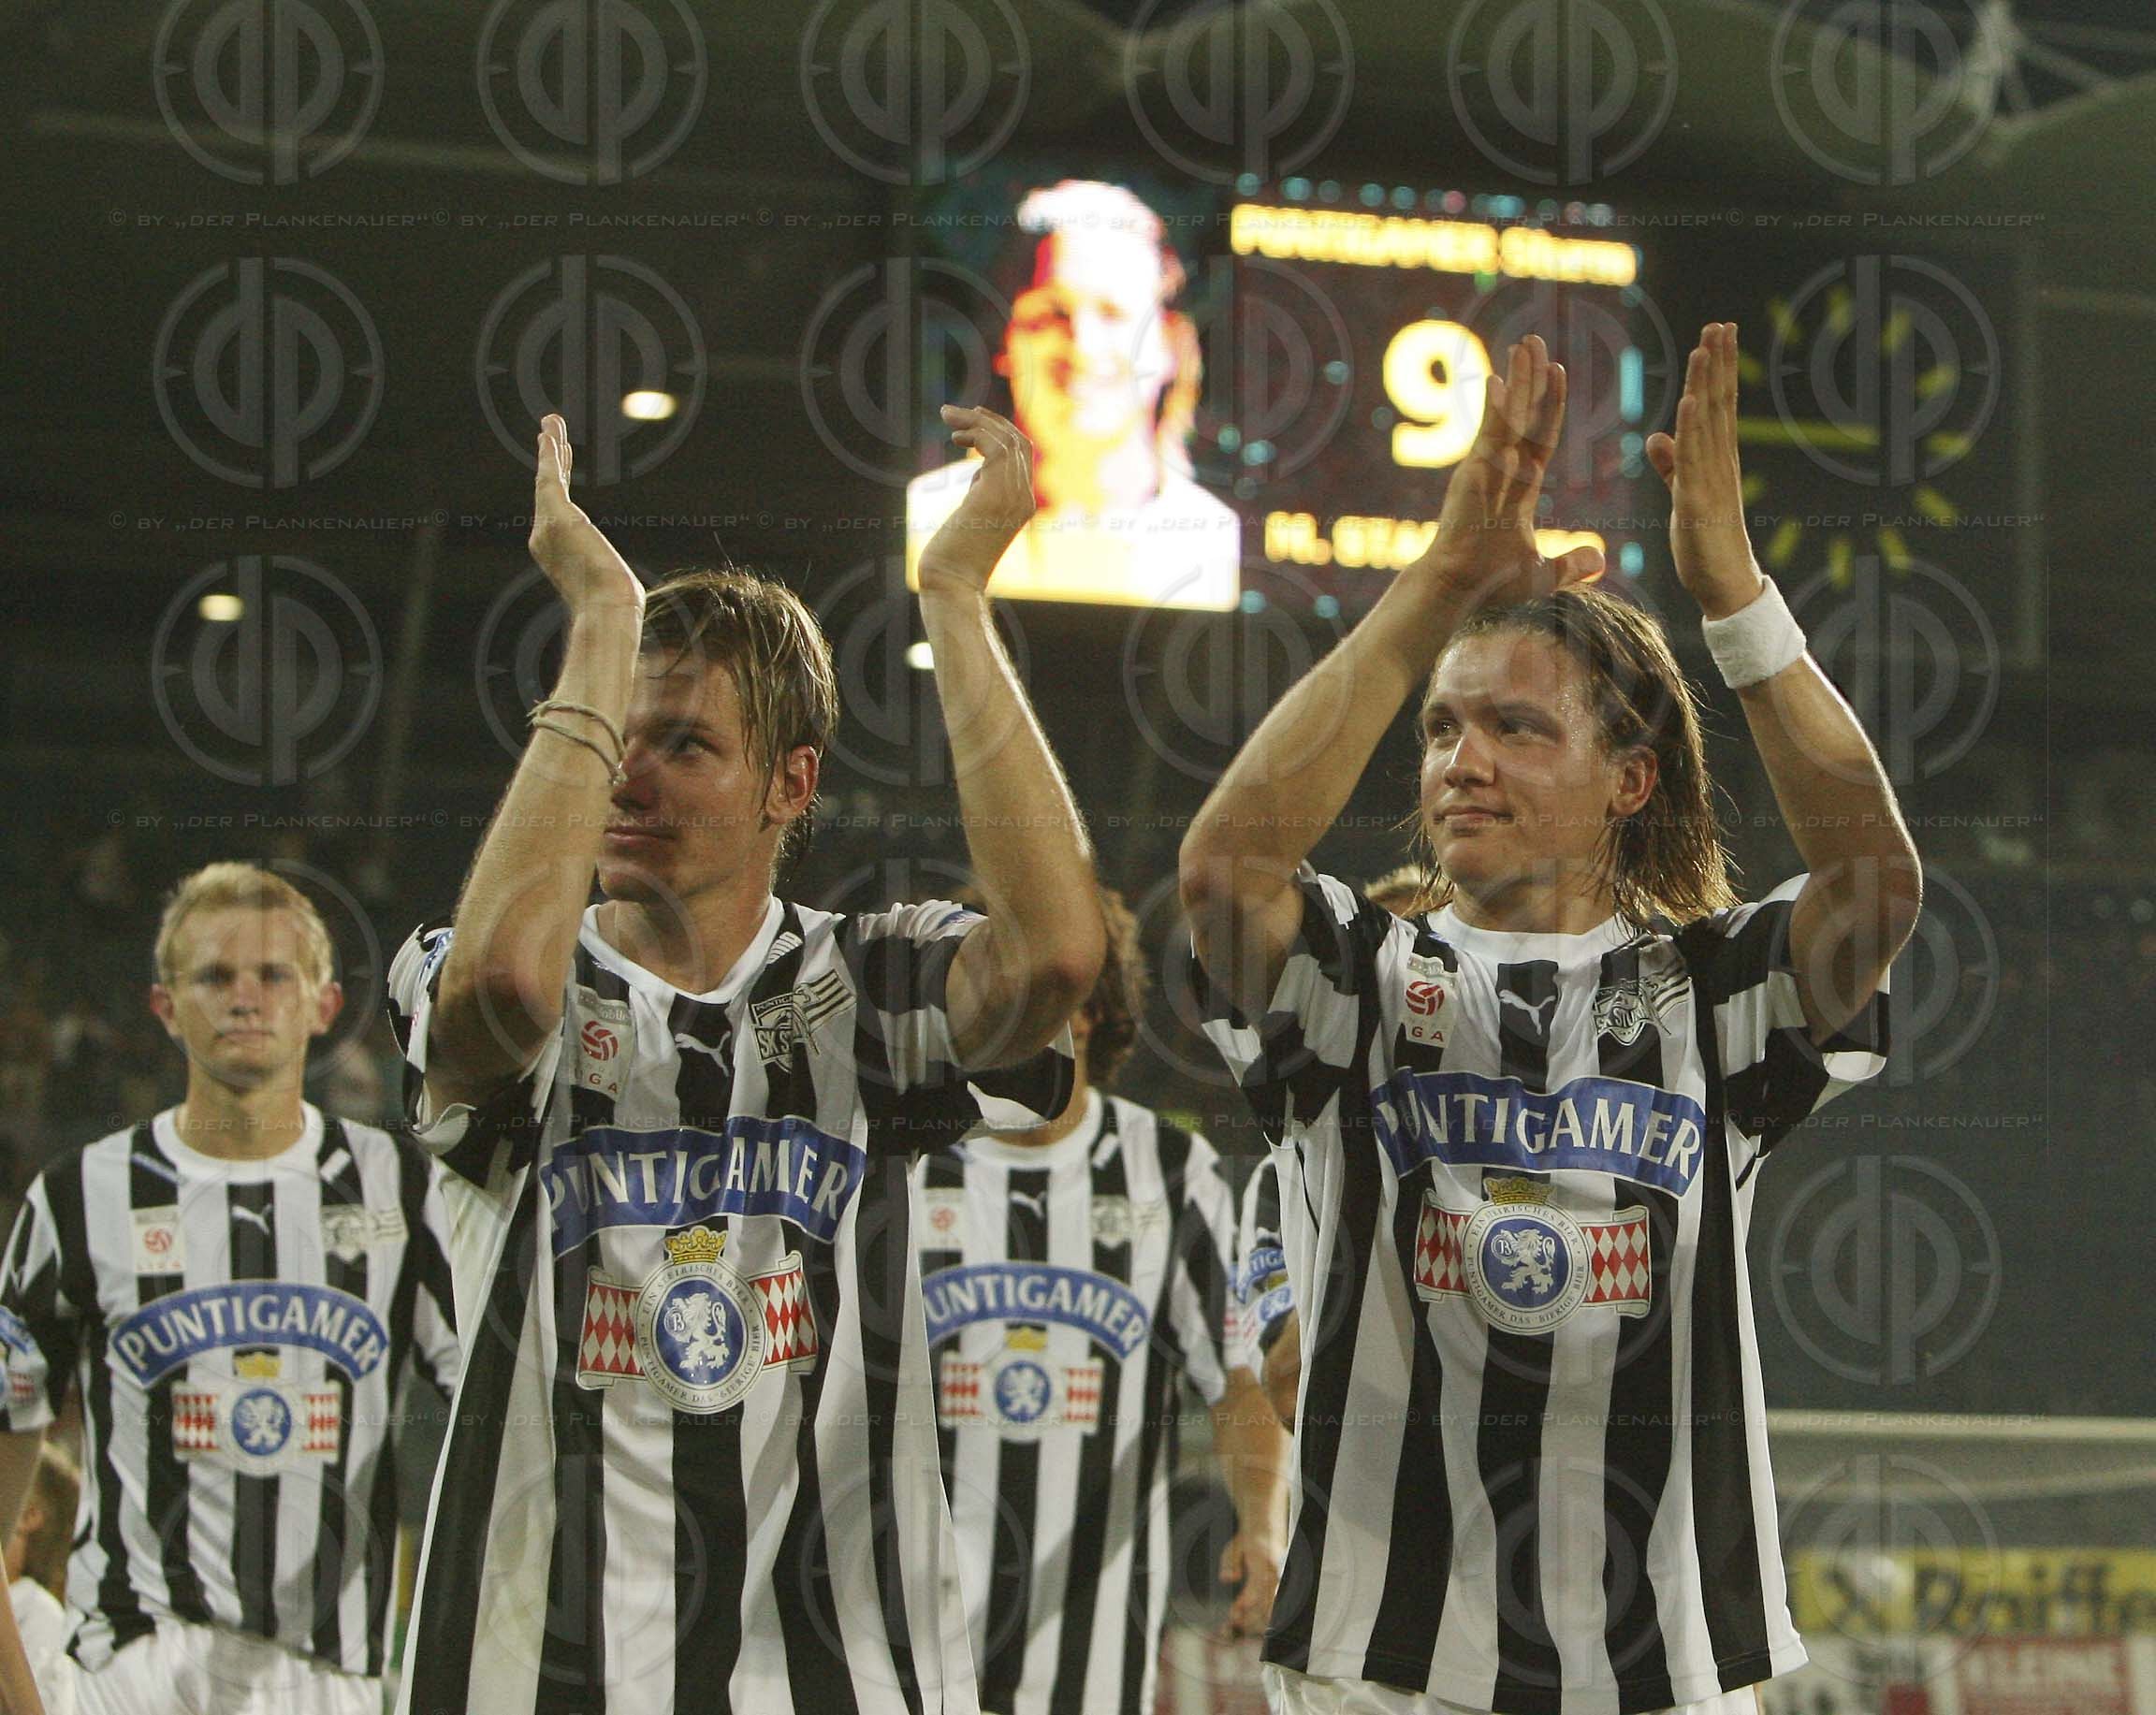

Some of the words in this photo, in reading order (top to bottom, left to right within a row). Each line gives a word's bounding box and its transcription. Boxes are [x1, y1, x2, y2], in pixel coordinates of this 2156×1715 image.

[1383, 319, 1493, 468] 9
[120, 1294, 386, 1375] PUNTIGAMER
[925, 1273, 1146, 1348] UNTIGAMER
